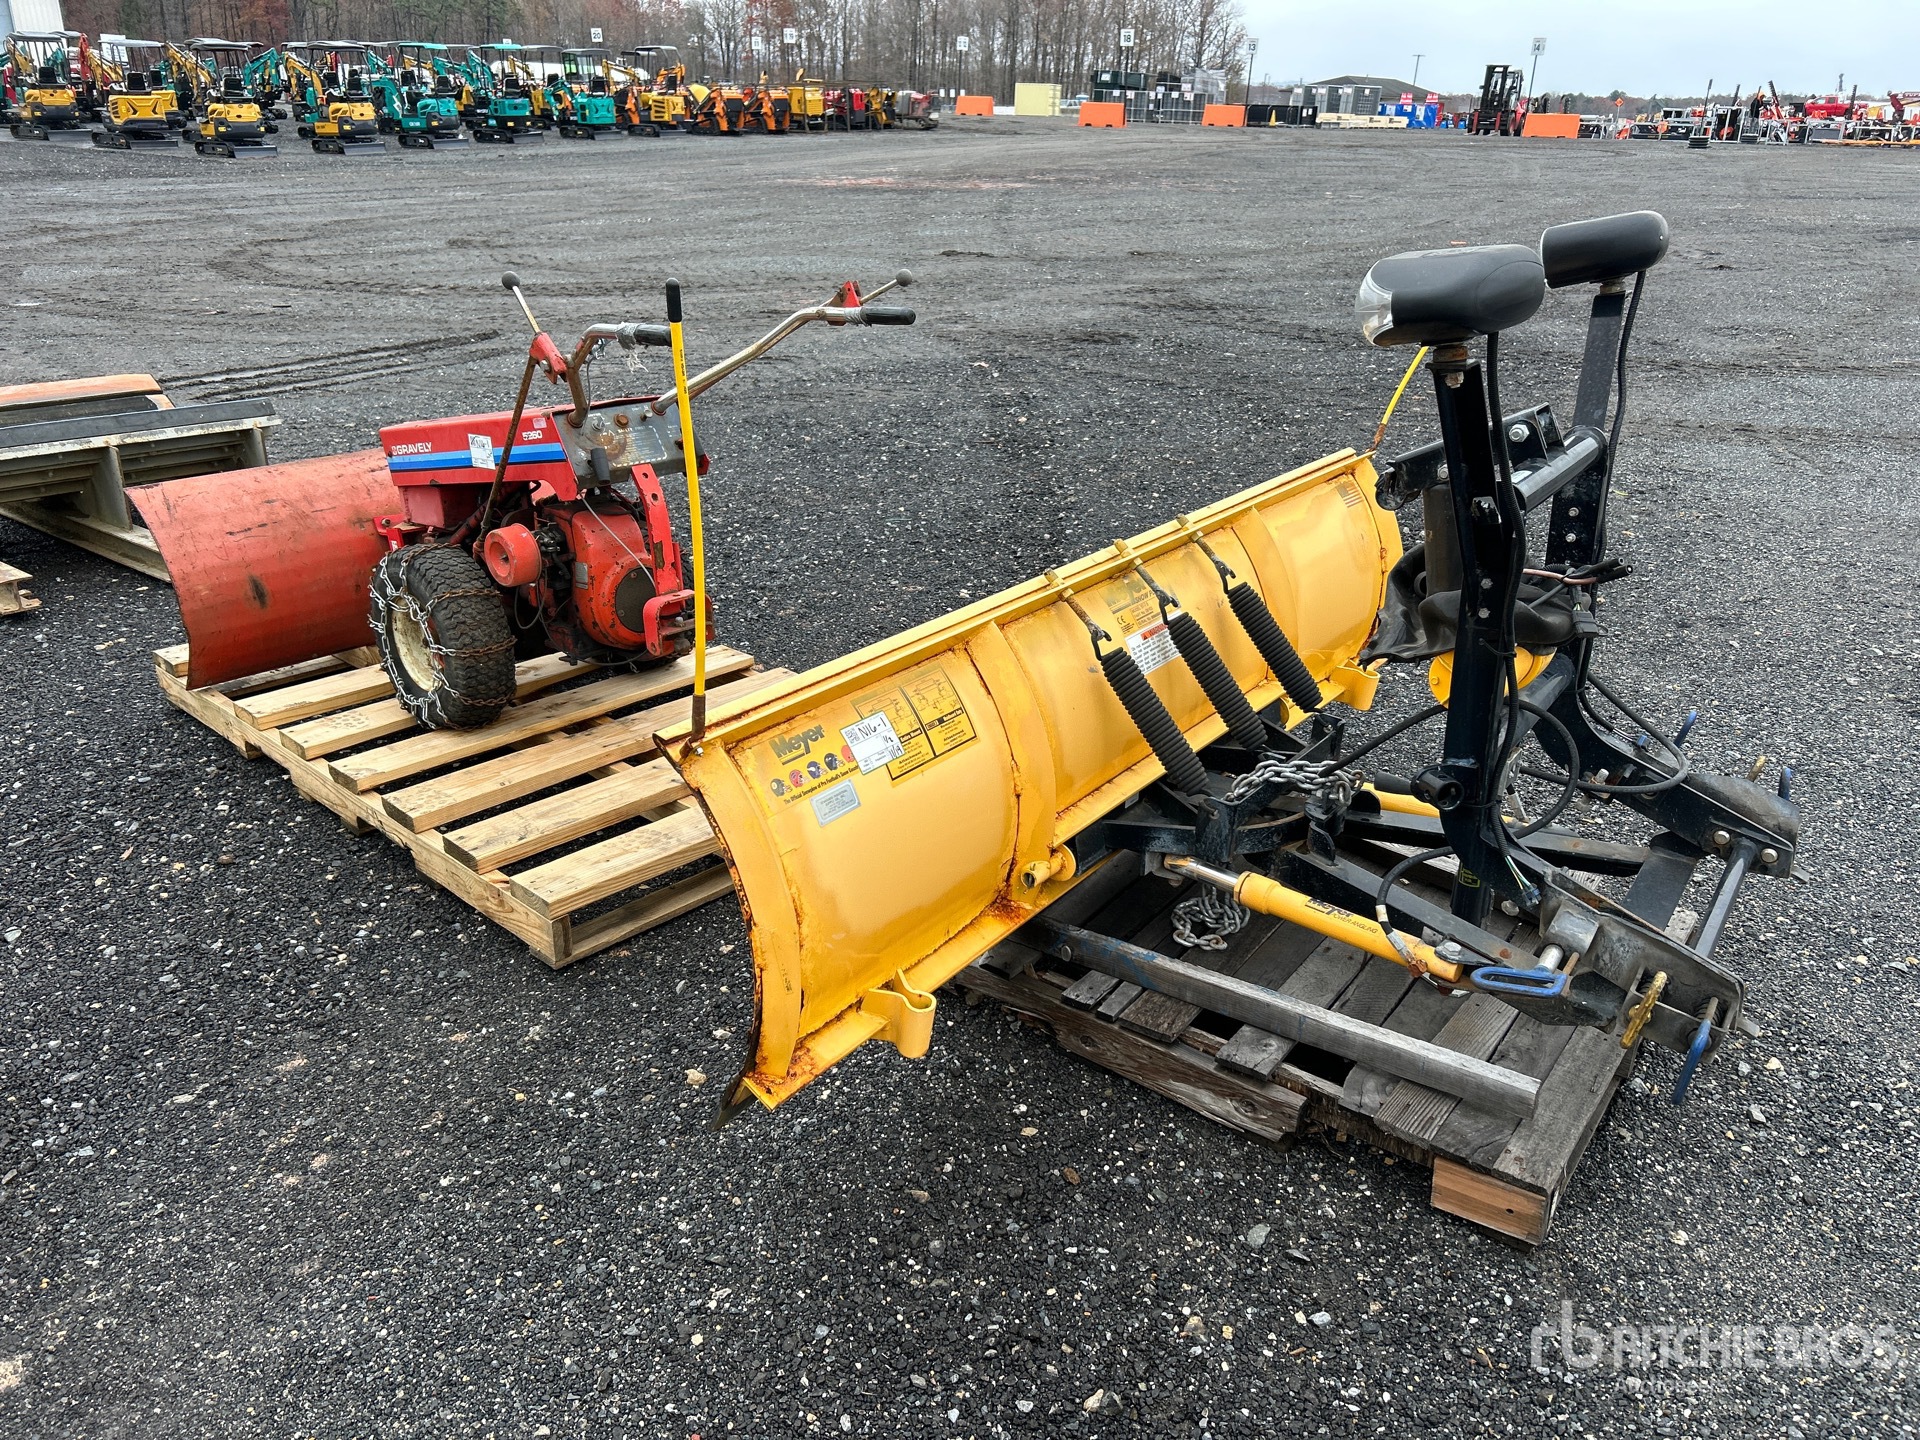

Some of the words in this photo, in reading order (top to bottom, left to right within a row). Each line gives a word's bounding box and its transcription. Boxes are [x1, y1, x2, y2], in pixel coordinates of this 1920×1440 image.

[592, 32, 601, 40] 20
[1123, 34, 1131, 43] 18
[1248, 43, 1256, 51] 13
[1533, 43, 1540, 51] 14
[522, 430, 543, 441] 5260
[396, 441, 433, 454] GRAVELY
[858, 716, 887, 740] N16-1
[769, 724, 825, 758] Meyer
[1351, 920, 1379, 934] ANGLING
